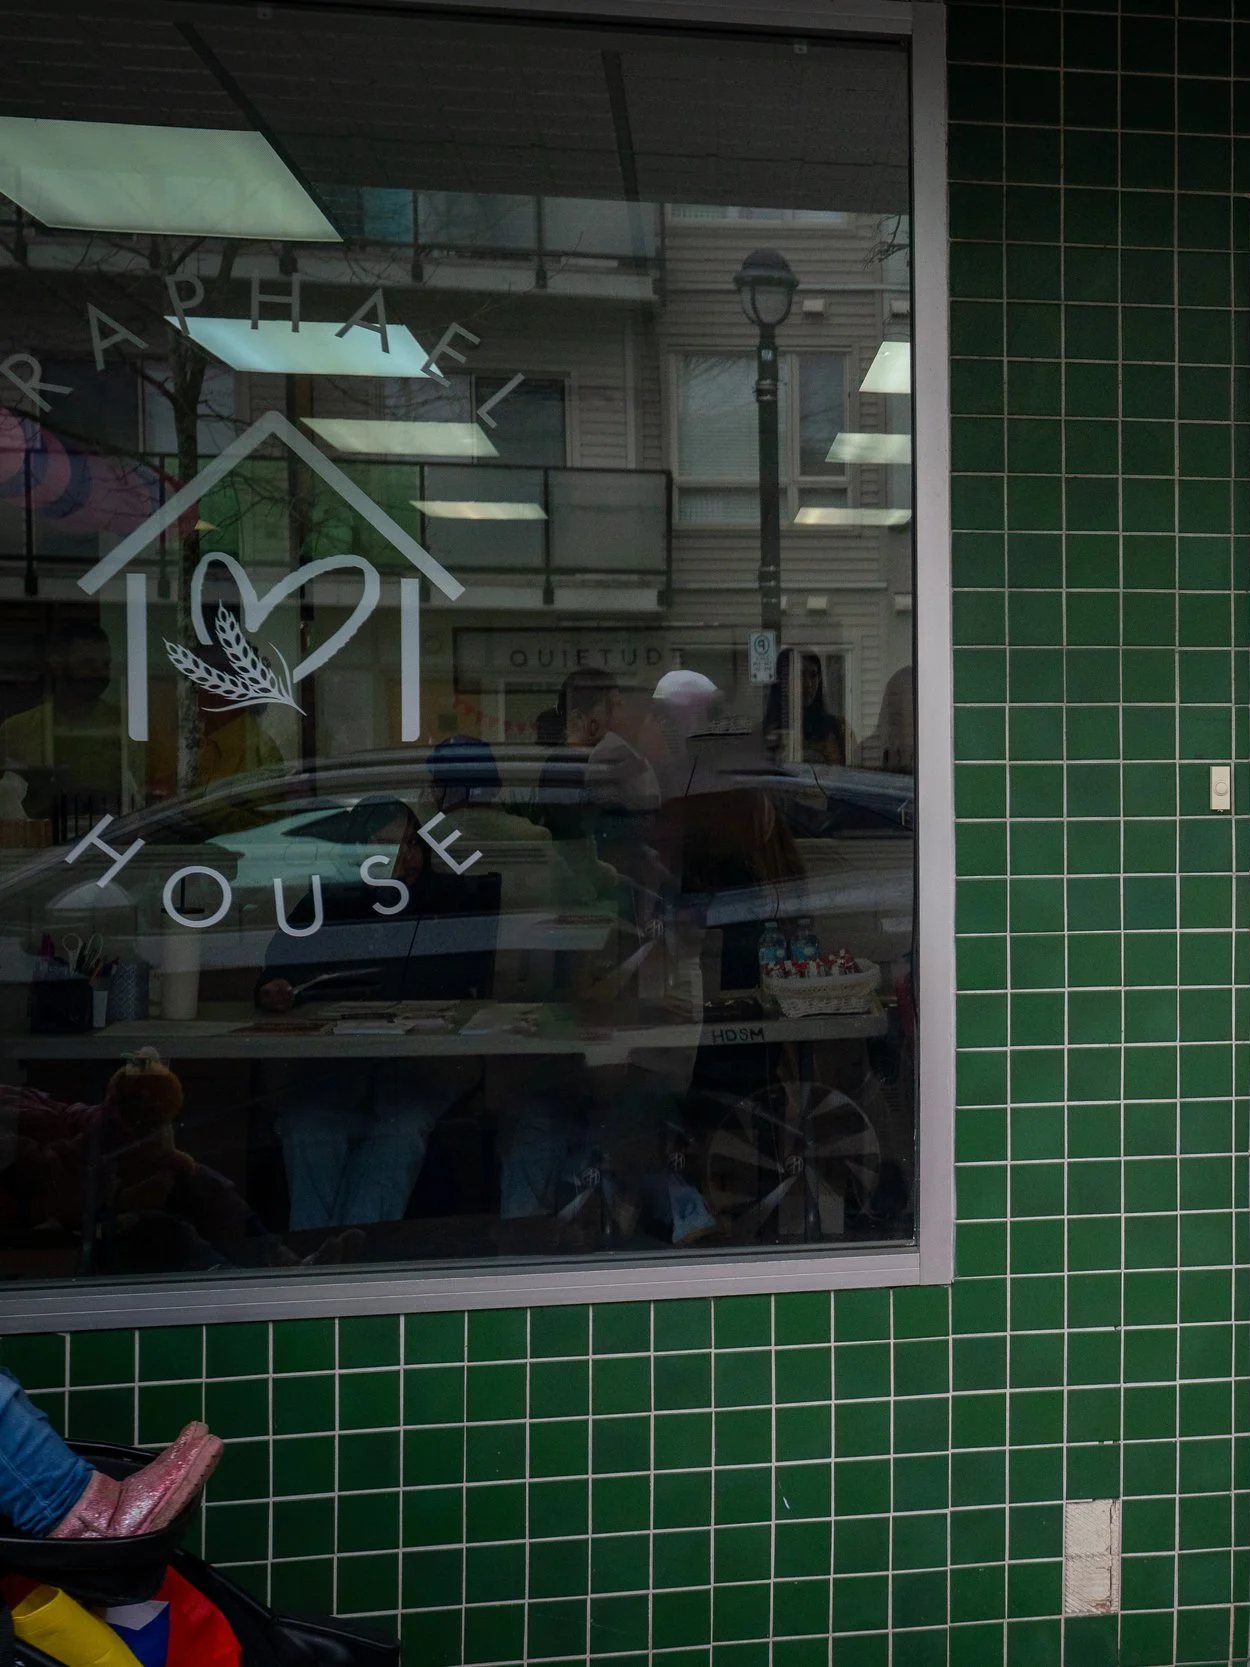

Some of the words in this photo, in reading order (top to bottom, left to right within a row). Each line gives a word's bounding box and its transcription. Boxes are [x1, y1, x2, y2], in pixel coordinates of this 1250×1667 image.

[0, 271, 525, 428] RAPHAEL
[64, 812, 483, 936] HOUSE
[712, 1028, 766, 1044] HDSM
